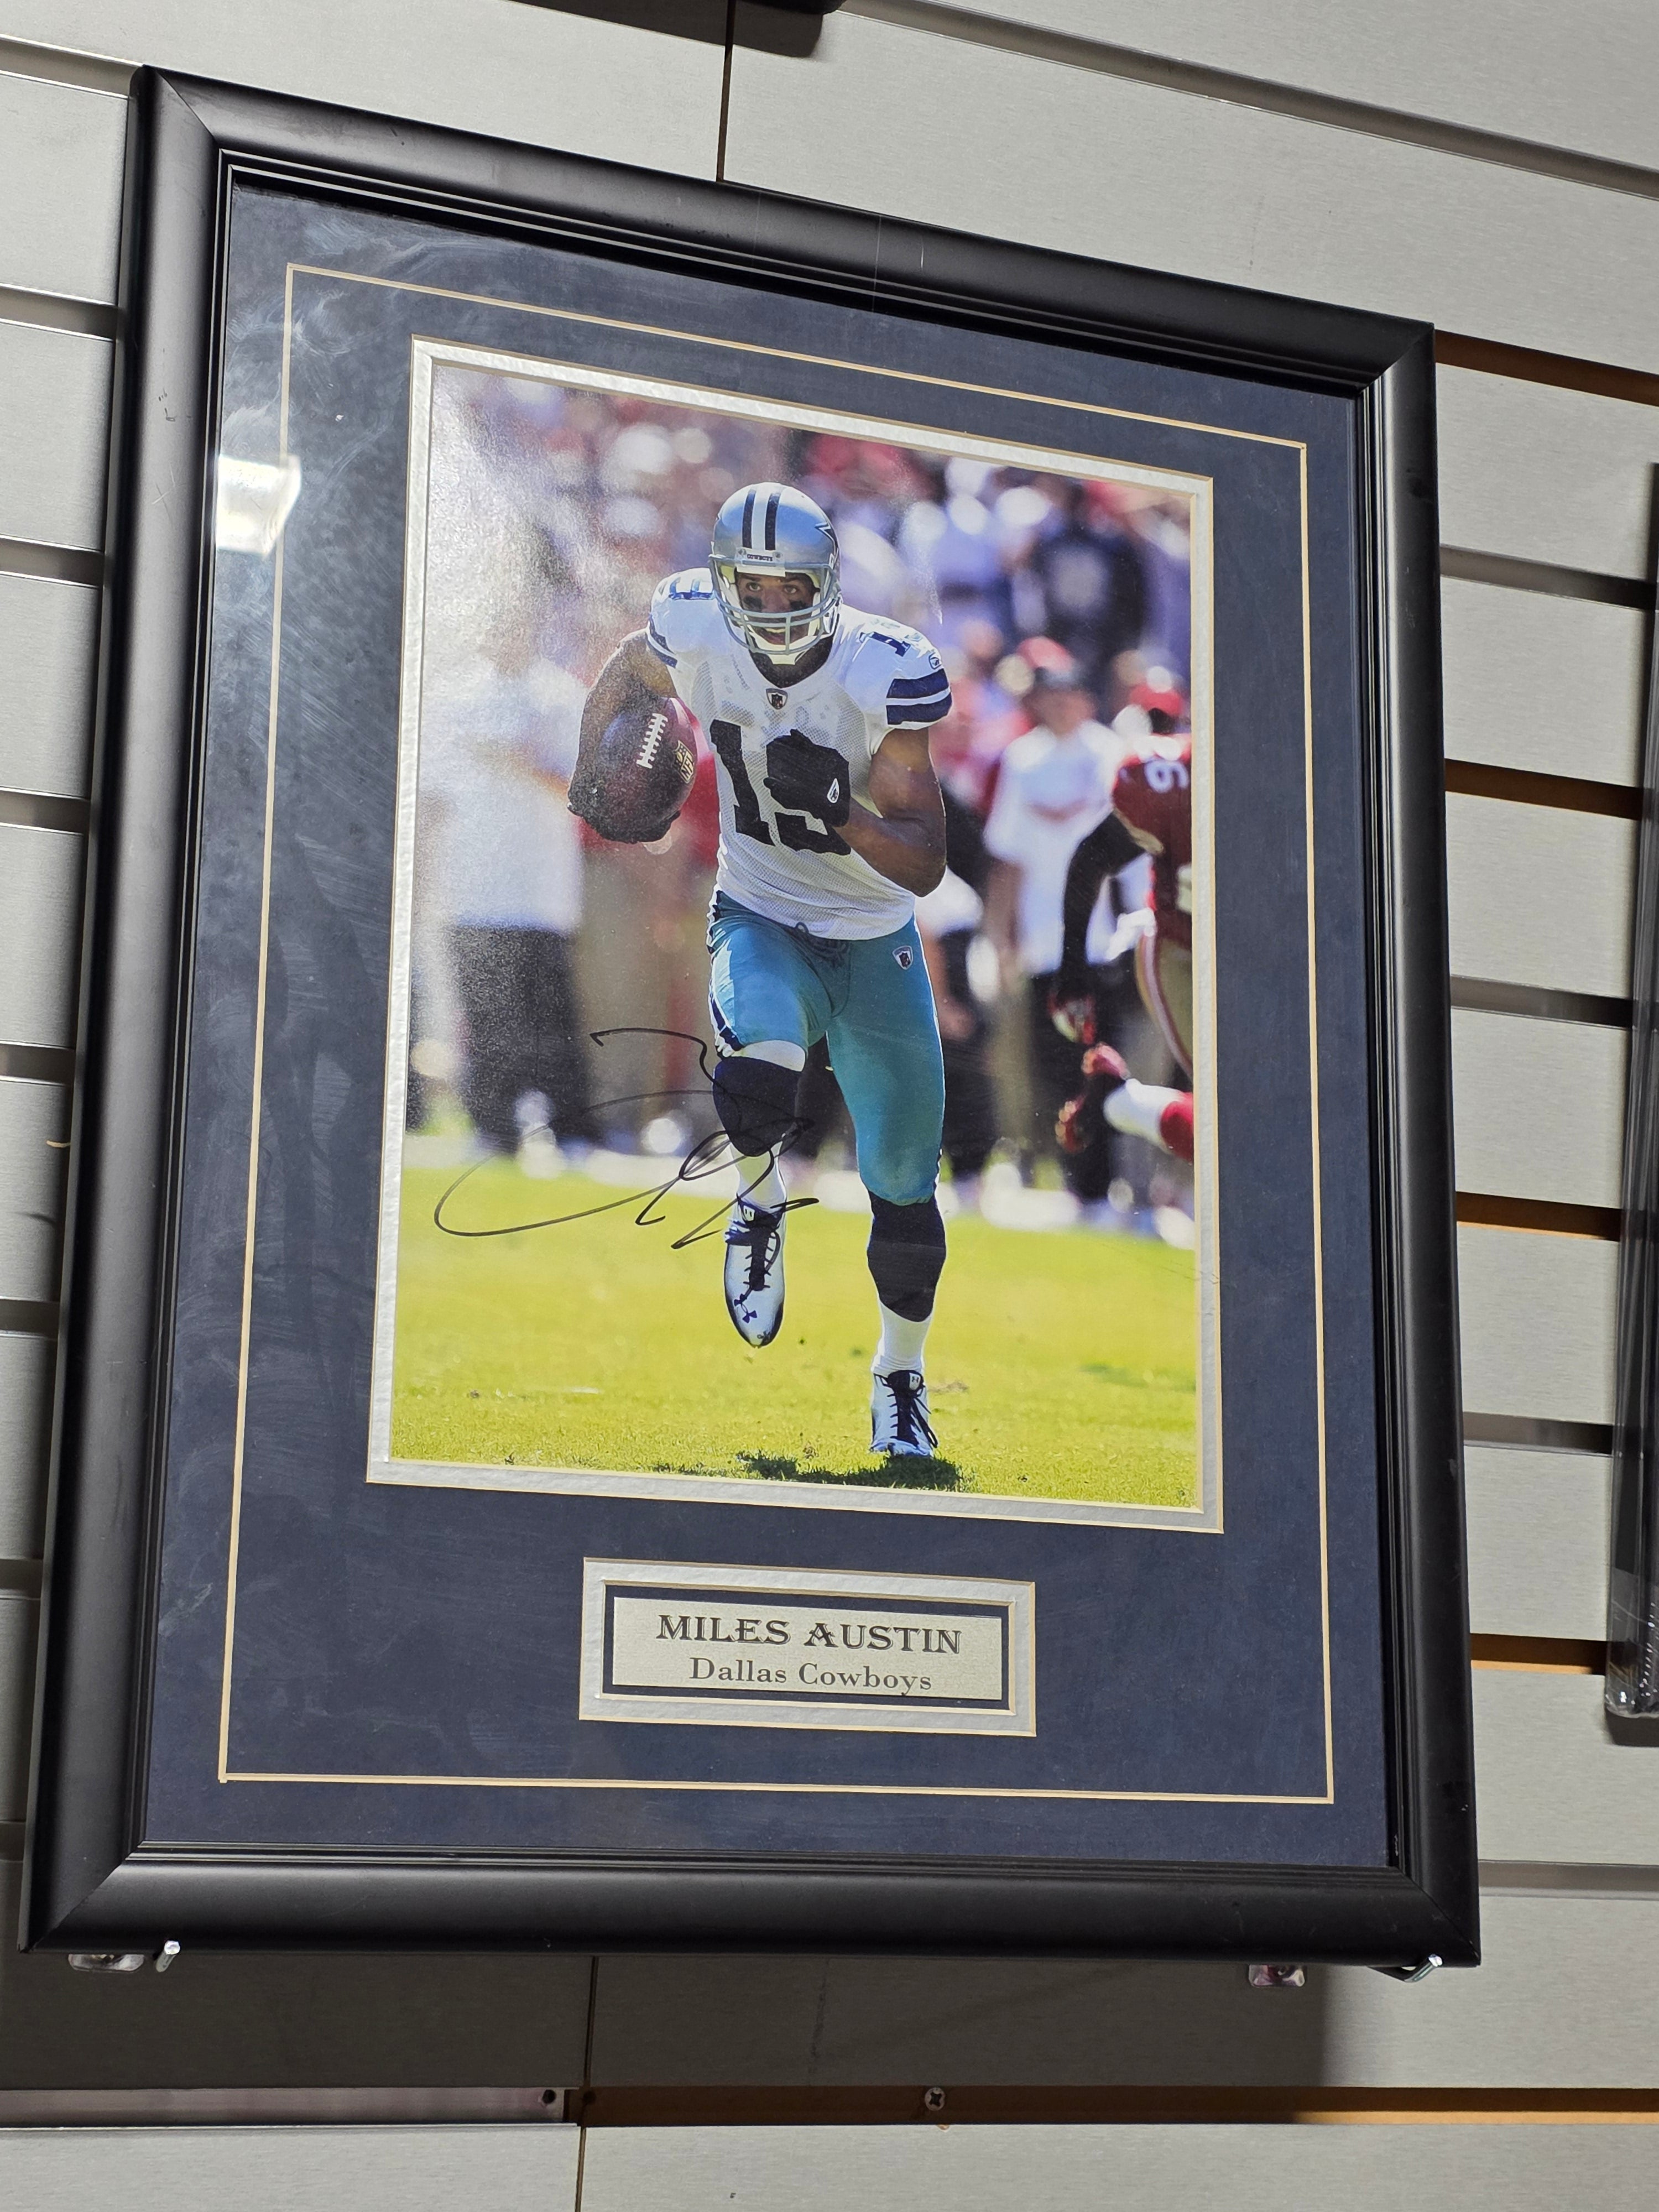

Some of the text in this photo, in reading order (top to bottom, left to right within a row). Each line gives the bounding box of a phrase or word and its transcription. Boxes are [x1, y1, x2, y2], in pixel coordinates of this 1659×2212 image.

[656, 1614, 963, 1654] MILES AUSTIN
[689, 1657, 932, 1696] Dallas Cowboys
